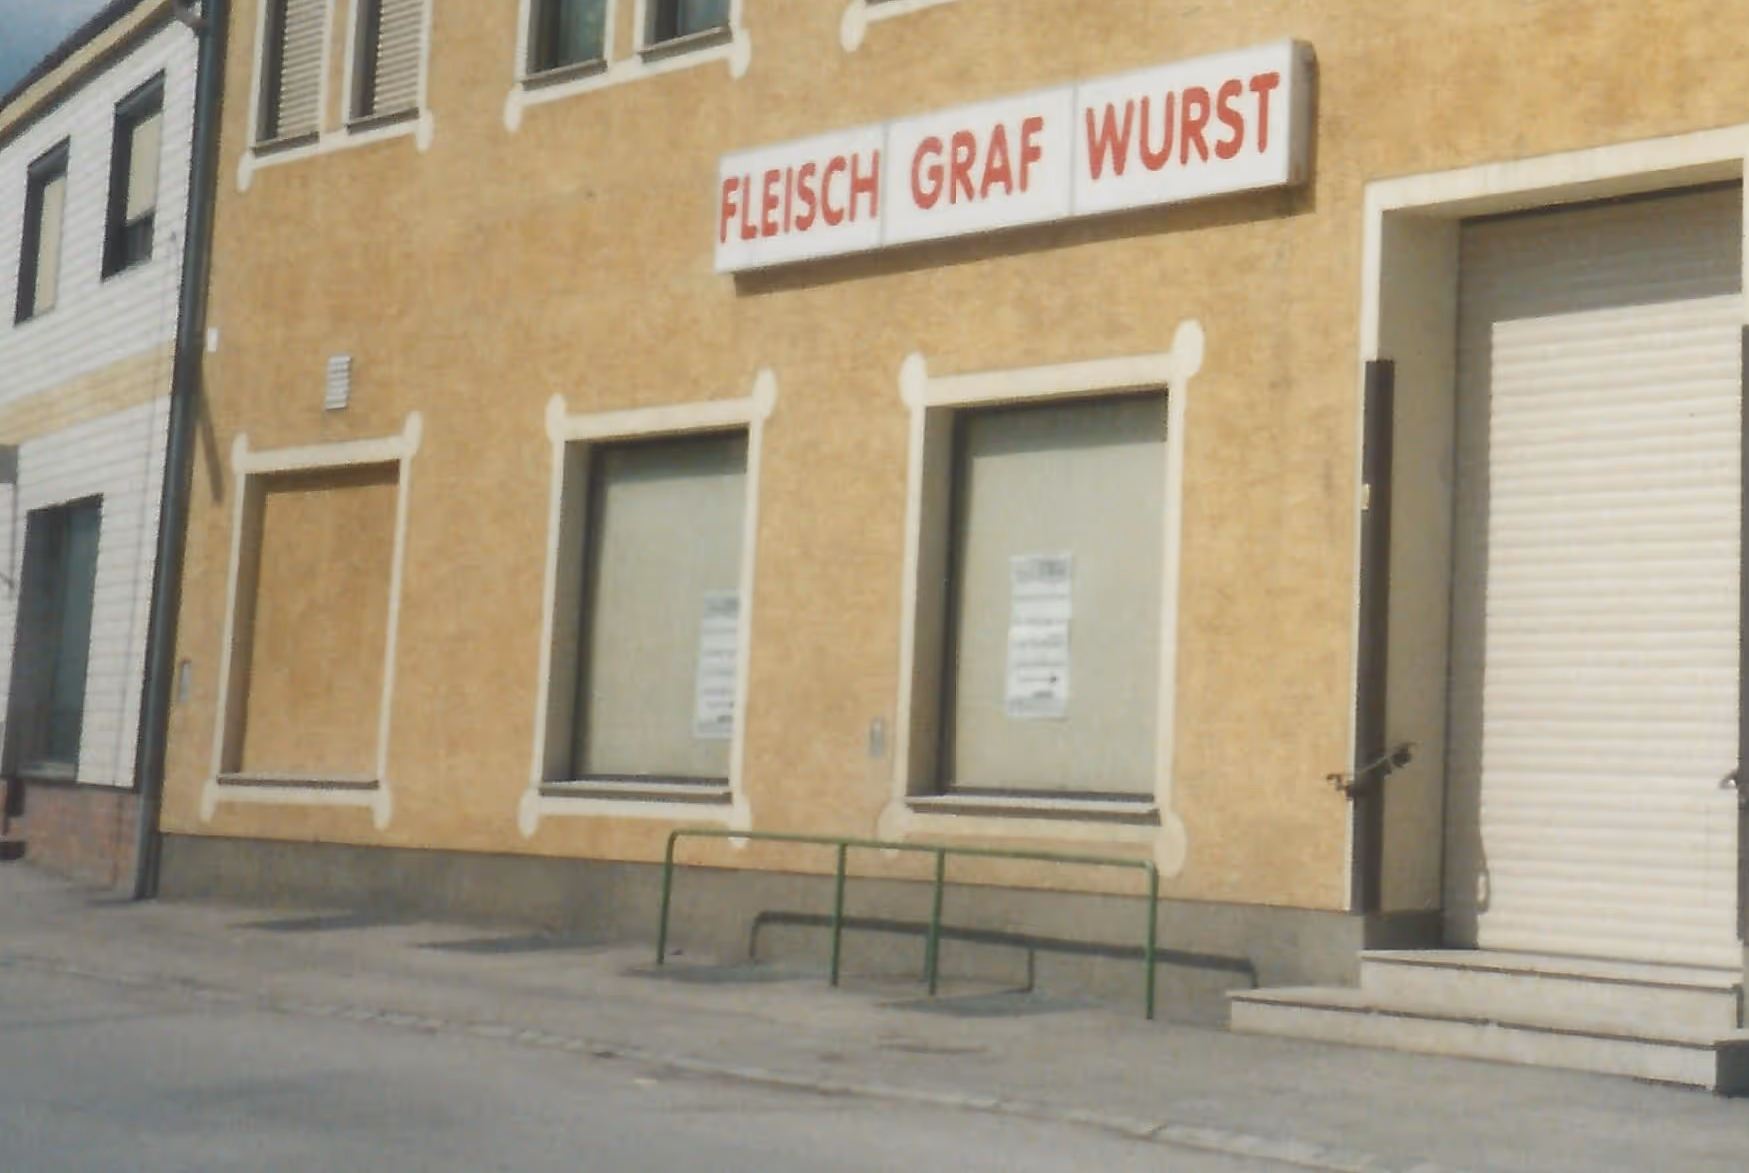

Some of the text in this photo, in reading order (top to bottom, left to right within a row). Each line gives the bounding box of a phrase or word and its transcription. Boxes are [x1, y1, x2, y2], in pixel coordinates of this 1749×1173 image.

[720, 71, 1280, 243] FLEISCH GRAF WURST
